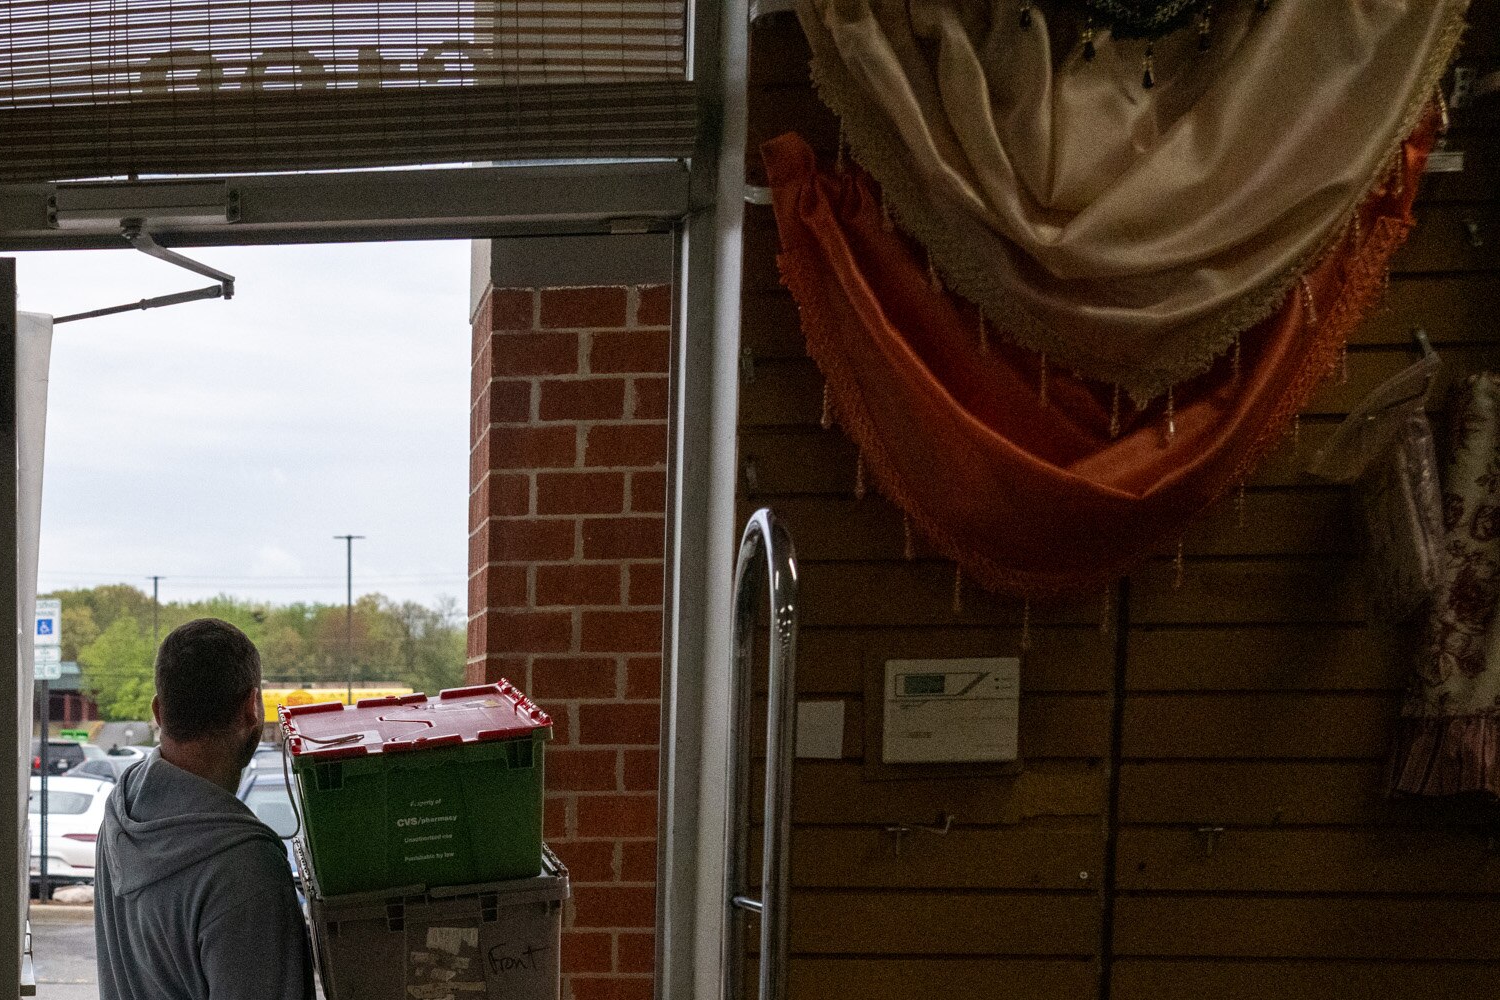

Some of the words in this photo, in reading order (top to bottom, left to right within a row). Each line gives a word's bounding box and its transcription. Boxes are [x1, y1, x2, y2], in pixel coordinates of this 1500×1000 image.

[409, 799, 435, 807] Pperty
[396, 815, 458, 828] CVS/pharmacy
[486, 942, 552, 975] Front
